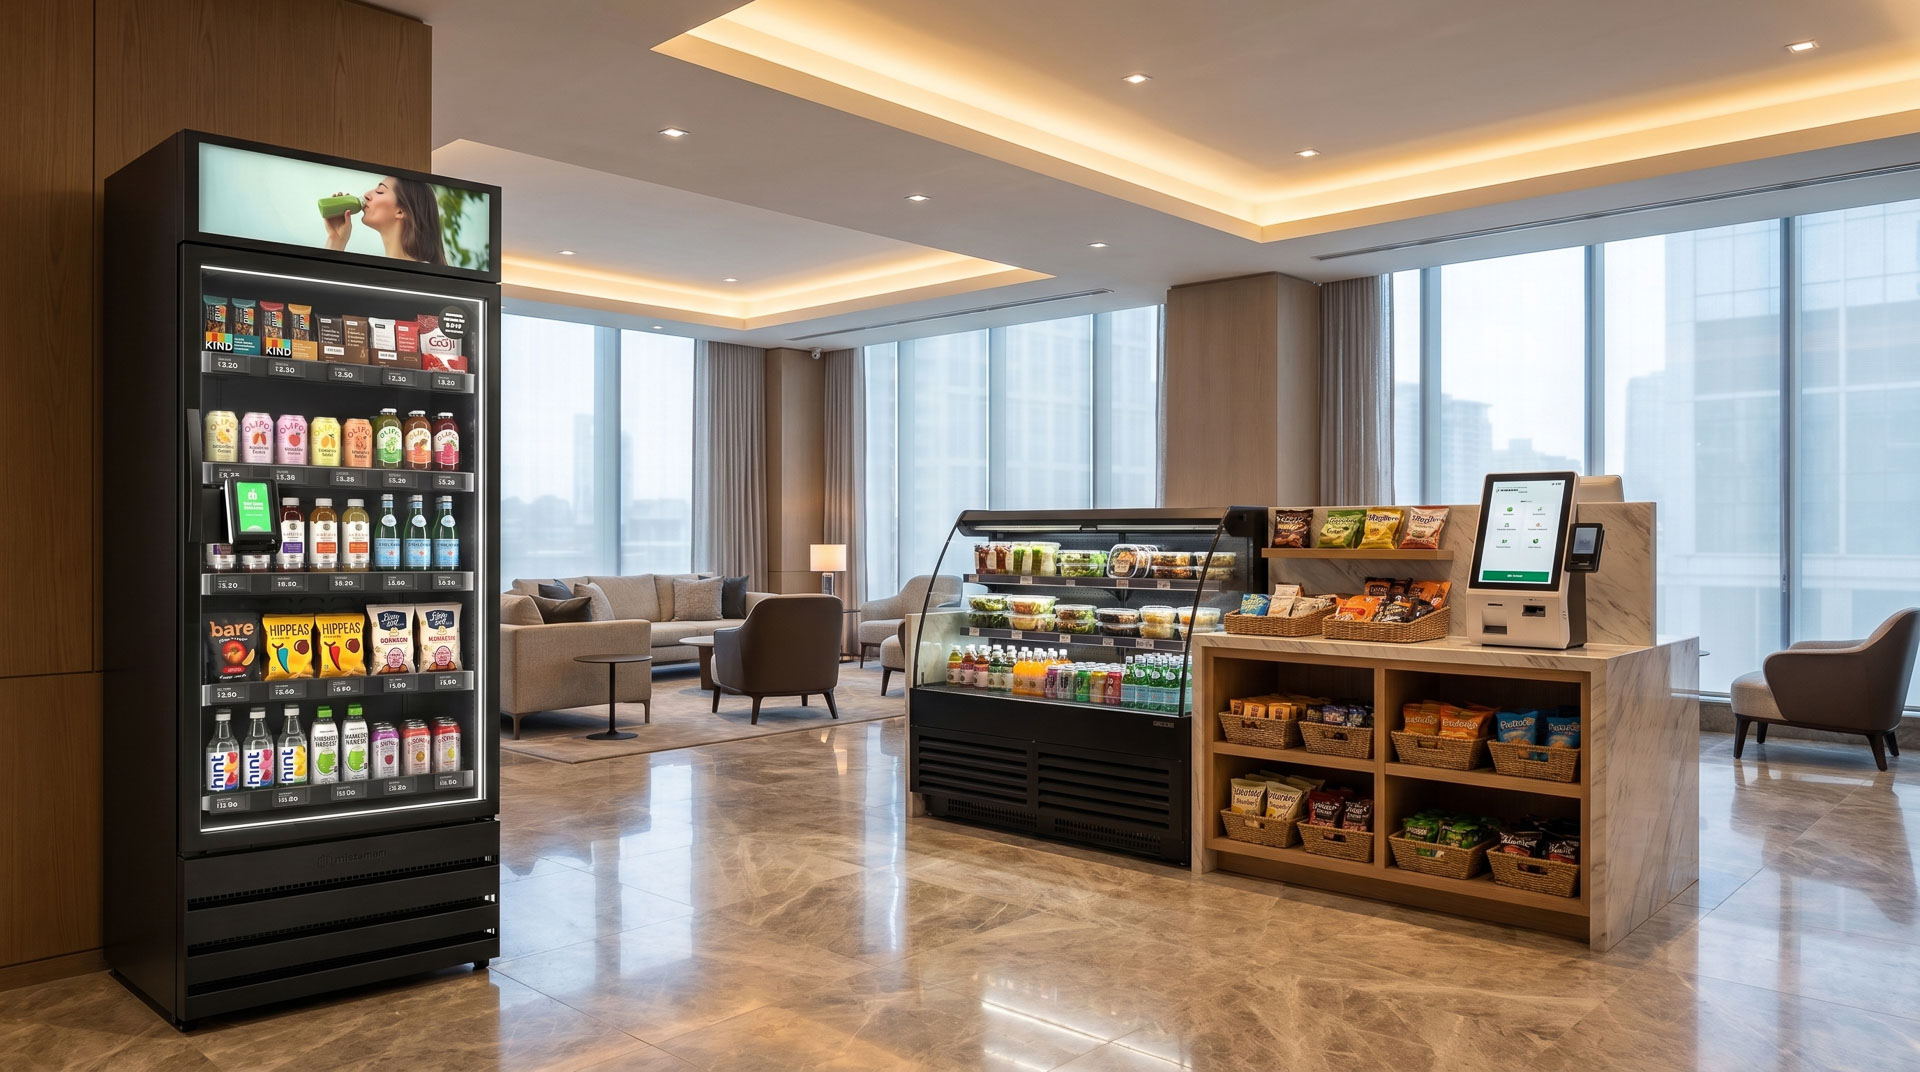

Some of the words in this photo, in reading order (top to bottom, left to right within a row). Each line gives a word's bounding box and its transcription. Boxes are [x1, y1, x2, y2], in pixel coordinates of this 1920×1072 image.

[205, 340, 233, 352] KIND
[266, 346, 291, 357] KIND
[209, 620, 254, 637] bare
[269, 623, 310, 637] HIPPEAS
[322, 622, 361, 636] HIPPEAS
[211, 754, 224, 789] hint
[247, 751, 260, 785] hint
[281, 748, 294, 782] hint
